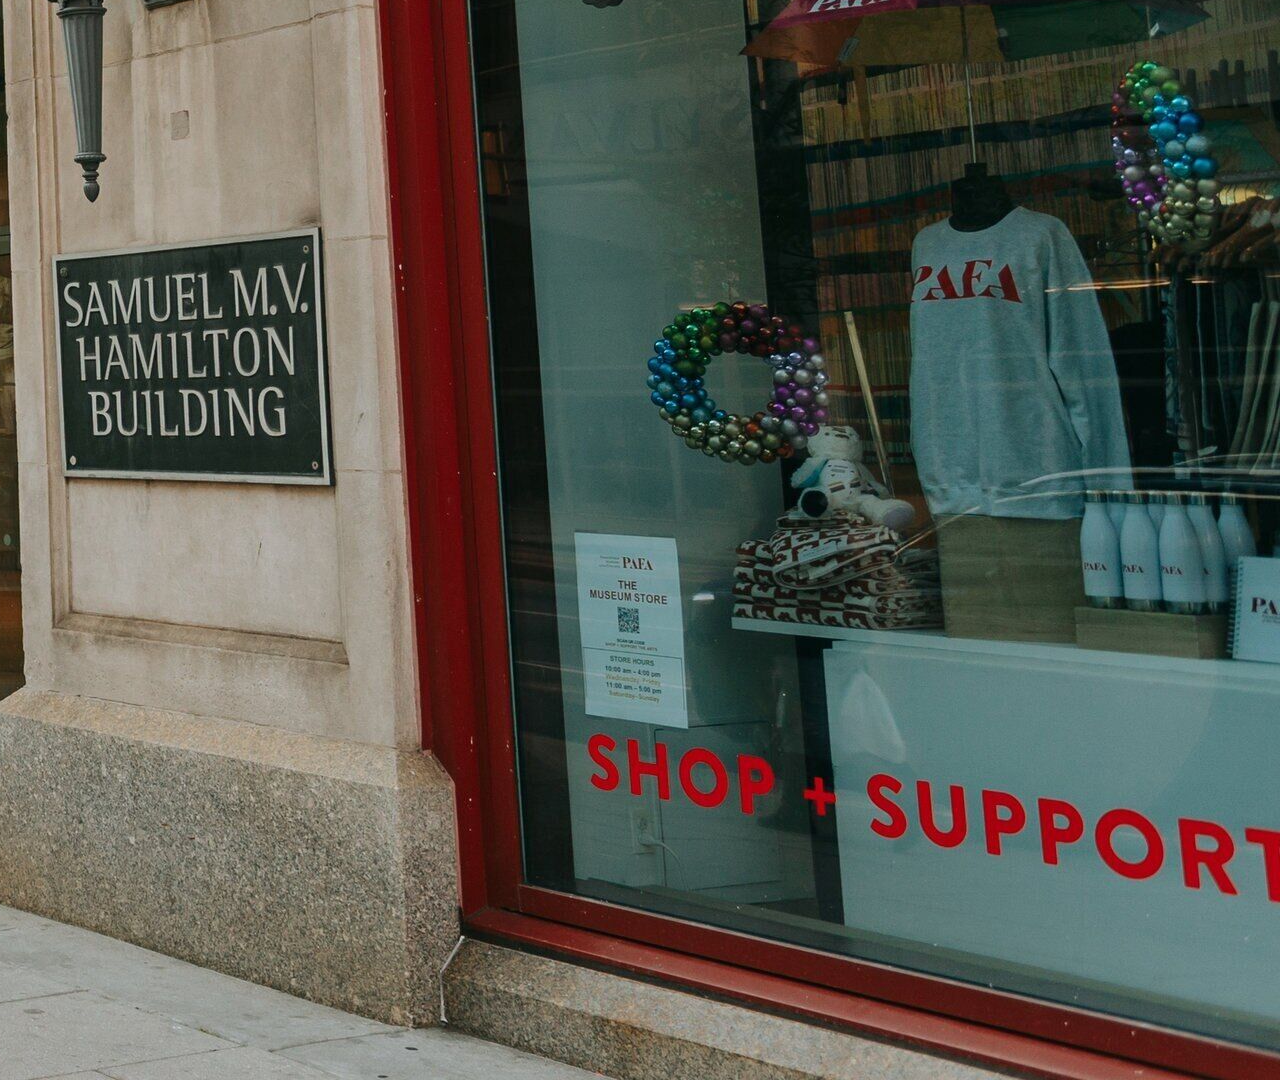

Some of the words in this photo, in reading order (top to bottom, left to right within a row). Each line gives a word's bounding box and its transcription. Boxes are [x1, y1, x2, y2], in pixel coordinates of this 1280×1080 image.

[64, 272, 223, 327] SAMUEL
[229, 262, 308, 317] M.V.
[76, 326, 295, 381] HAMILTON
[88, 386, 287, 437] BUILDING
[622, 557, 653, 570] PAFA
[1084, 562, 1107, 571] PAFA
[618, 580, 637, 590] THE
[590, 590, 632, 601] MUSEUM
[634, 593, 668, 605] STORE
[1251, 597, 1278, 615] PA
[610, 655, 630, 664] STORE
[605, 665, 621, 673] 10:00
[651, 671, 661, 679] pm
[652, 687, 662, 695] pm
[587, 732, 775, 816] SHOP
[803, 776, 837, 817] +
[865, 773, 1280, 903] SUPPORT
